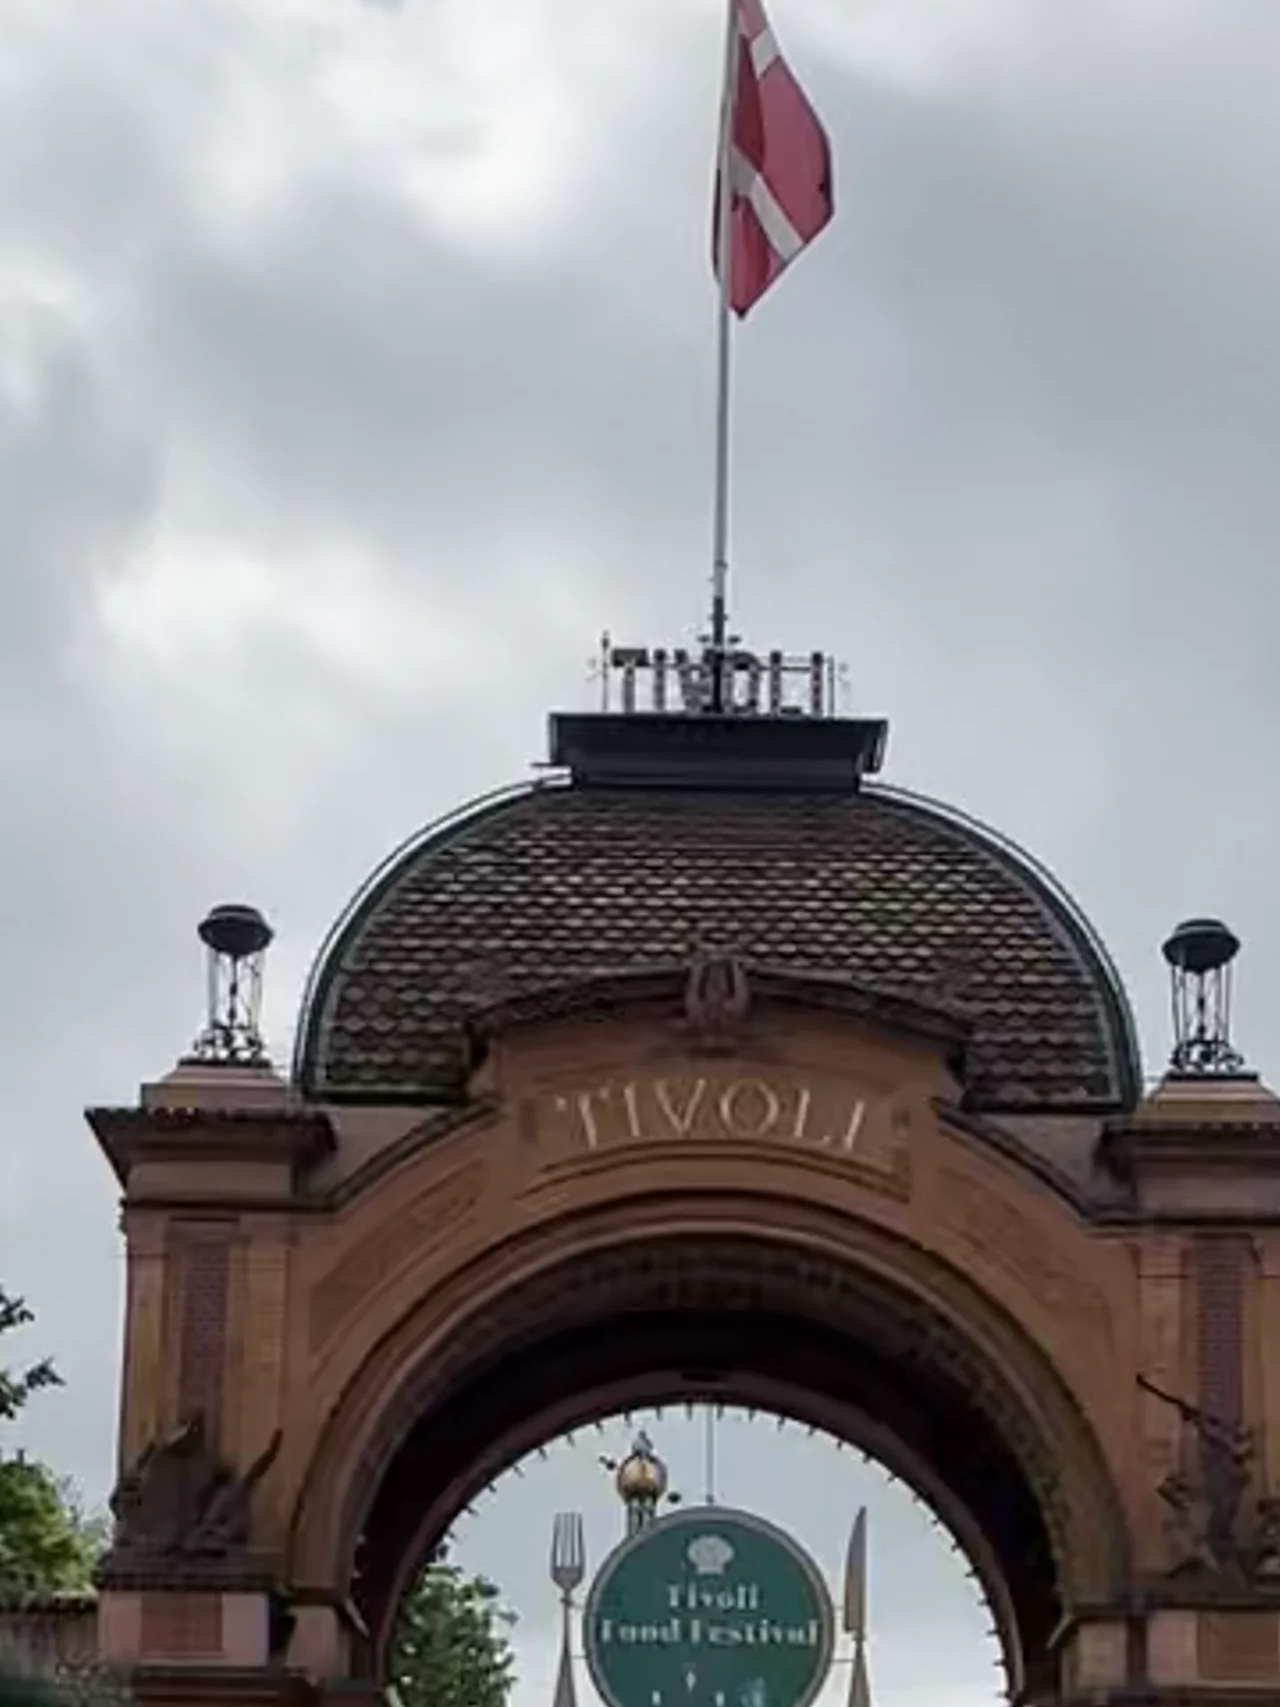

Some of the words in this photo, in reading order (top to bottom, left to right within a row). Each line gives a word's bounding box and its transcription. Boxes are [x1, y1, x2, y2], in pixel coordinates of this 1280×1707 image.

[555, 1078, 867, 1151] TIVOLI
[669, 1581, 759, 1610] Tivoli
[600, 1618, 680, 1643] Food
[689, 1618, 820, 1646] Festival
